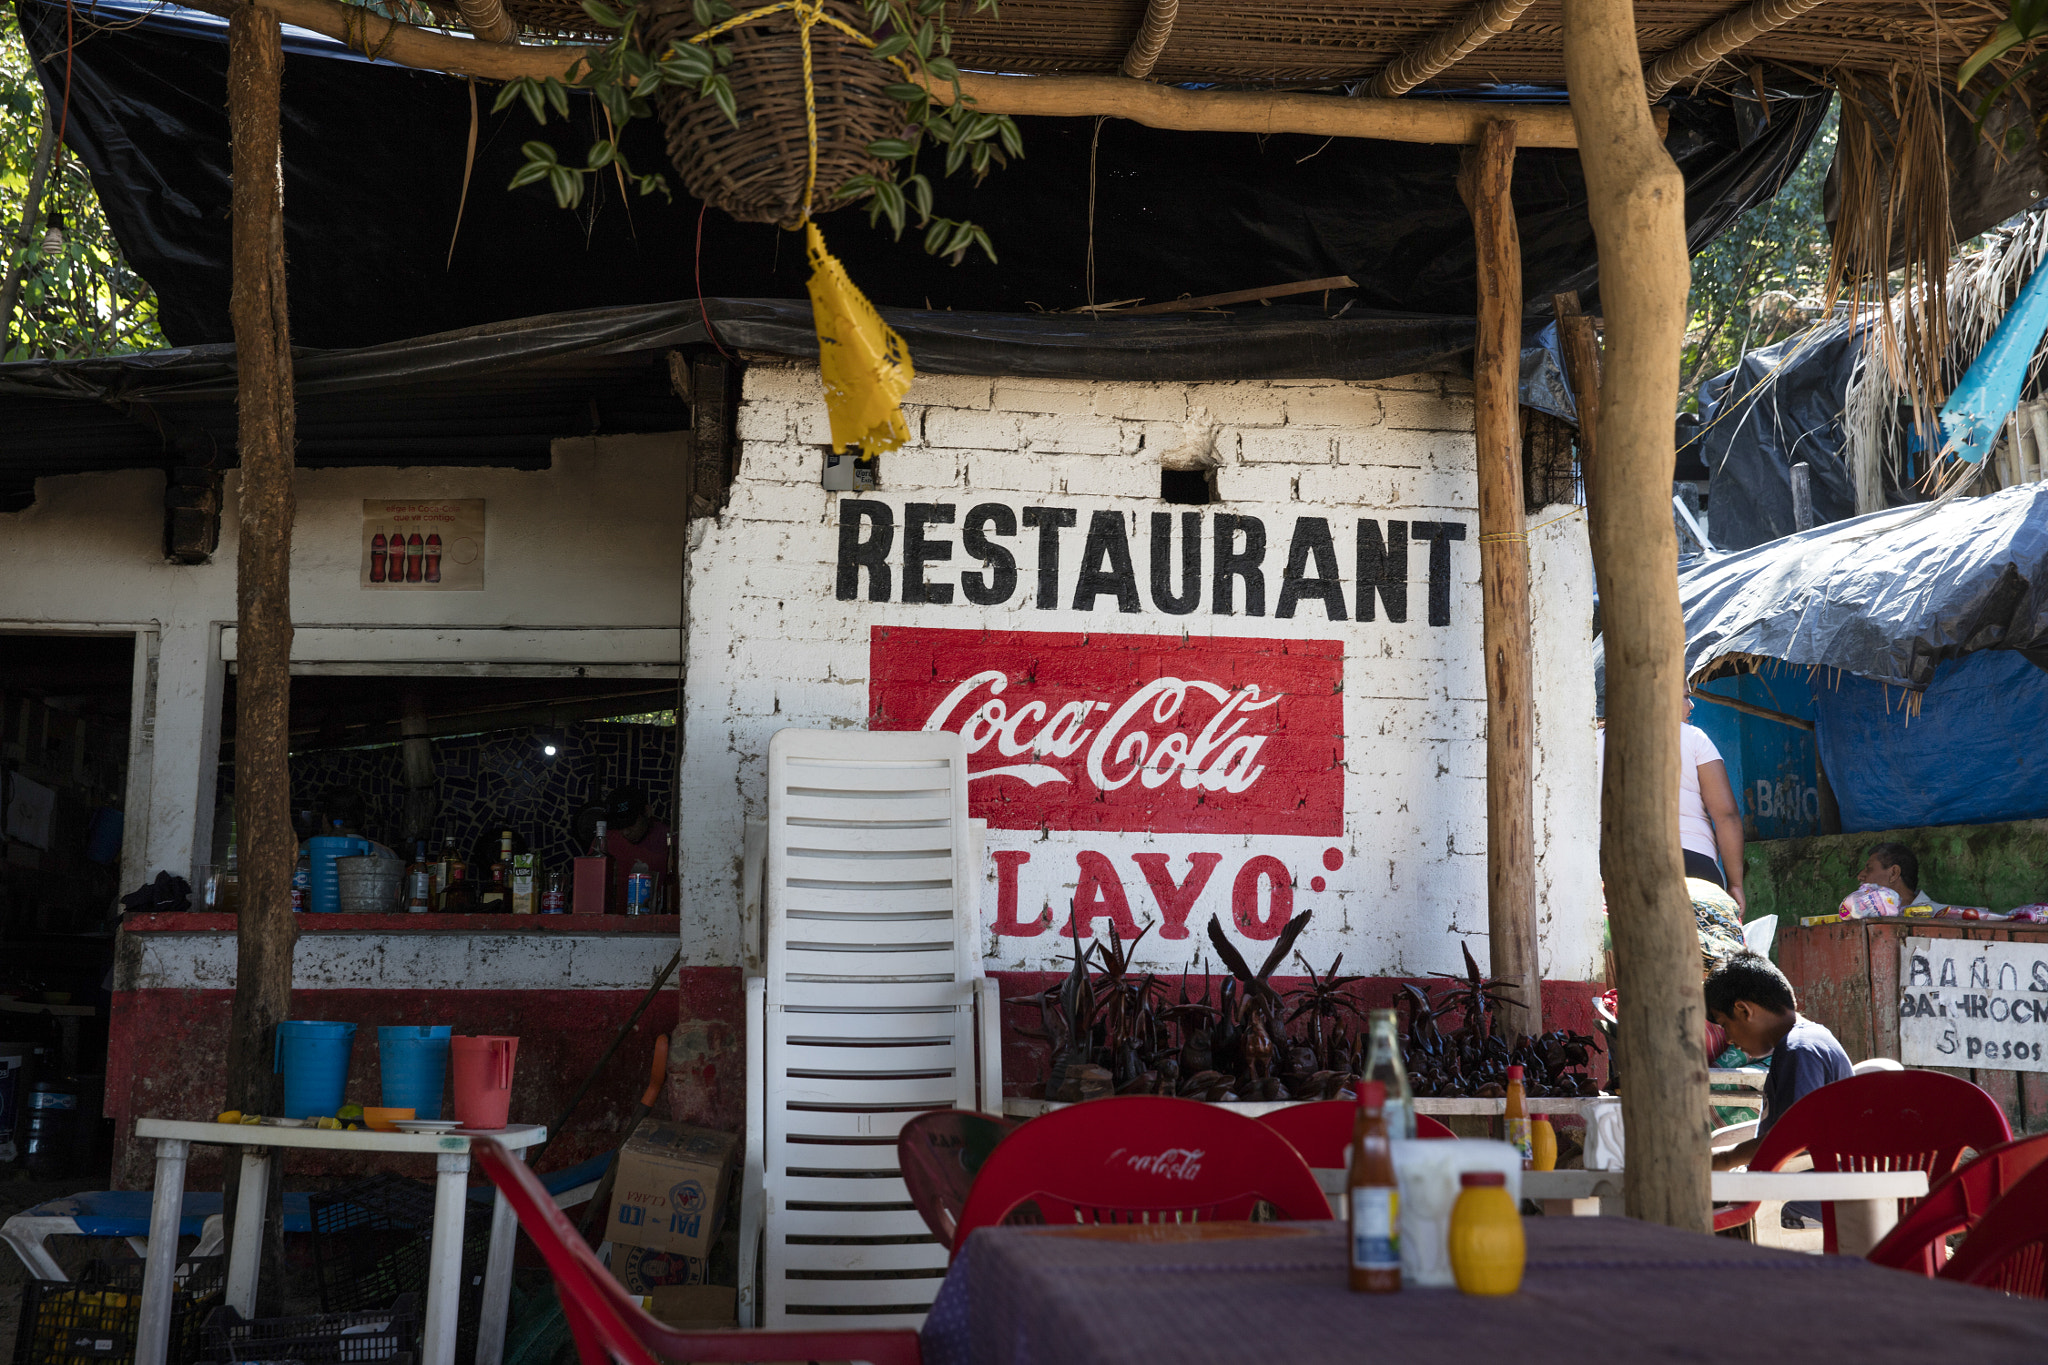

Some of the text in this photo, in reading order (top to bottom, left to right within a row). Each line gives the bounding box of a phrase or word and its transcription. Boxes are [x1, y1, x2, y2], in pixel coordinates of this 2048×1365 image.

[418, 504, 461, 513] Coca-Cola
[423, 514, 456, 522] contigo
[836, 498, 1467, 627] RESTAURANT
[922, 669, 1285, 794] Coca-Cola
[1757, 774, 1821, 823] BAÑO
[994, 850, 1295, 941] LAYO
[1910, 955, 2048, 992] BAÑOS
[1937, 1030, 2042, 1062] 5 pesos
[627, 1190, 666, 1207] CLARA
